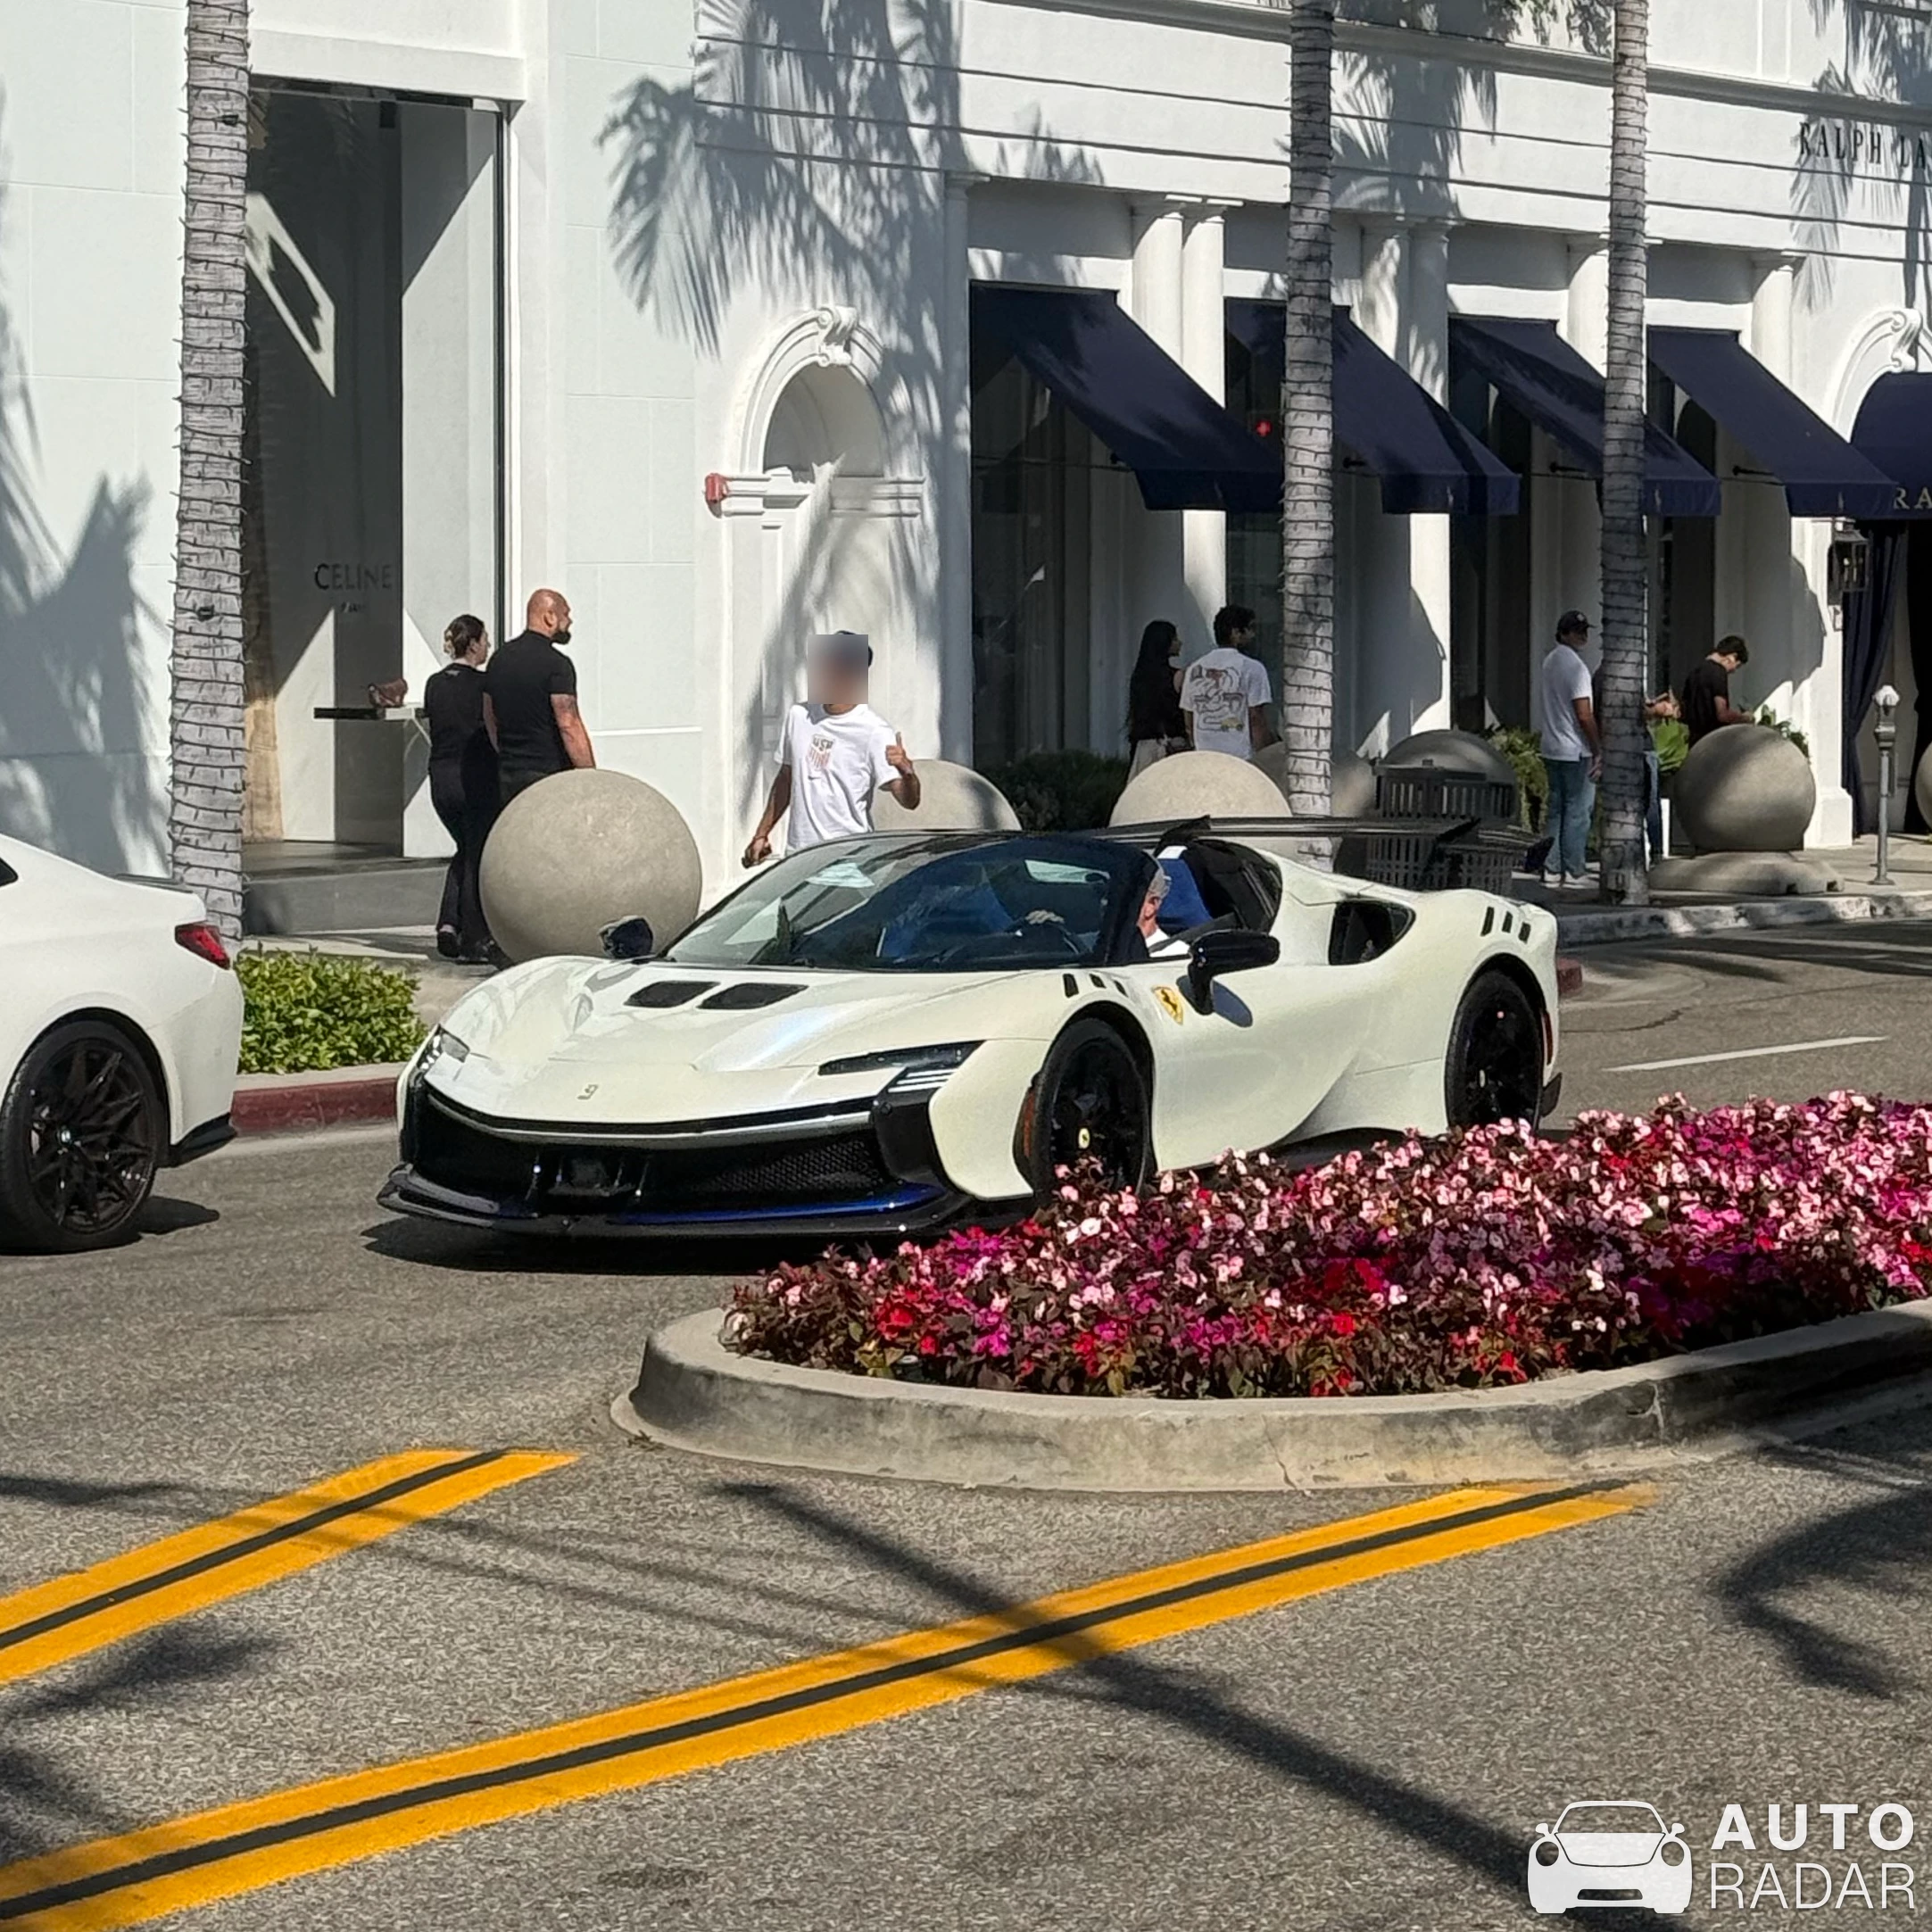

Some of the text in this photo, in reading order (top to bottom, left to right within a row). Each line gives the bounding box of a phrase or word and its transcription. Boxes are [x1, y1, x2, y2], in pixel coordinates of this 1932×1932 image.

[1800, 122, 1882, 165] RALPH
[1893, 487, 1932, 510] RA
[314, 563, 392, 590] CELINE
